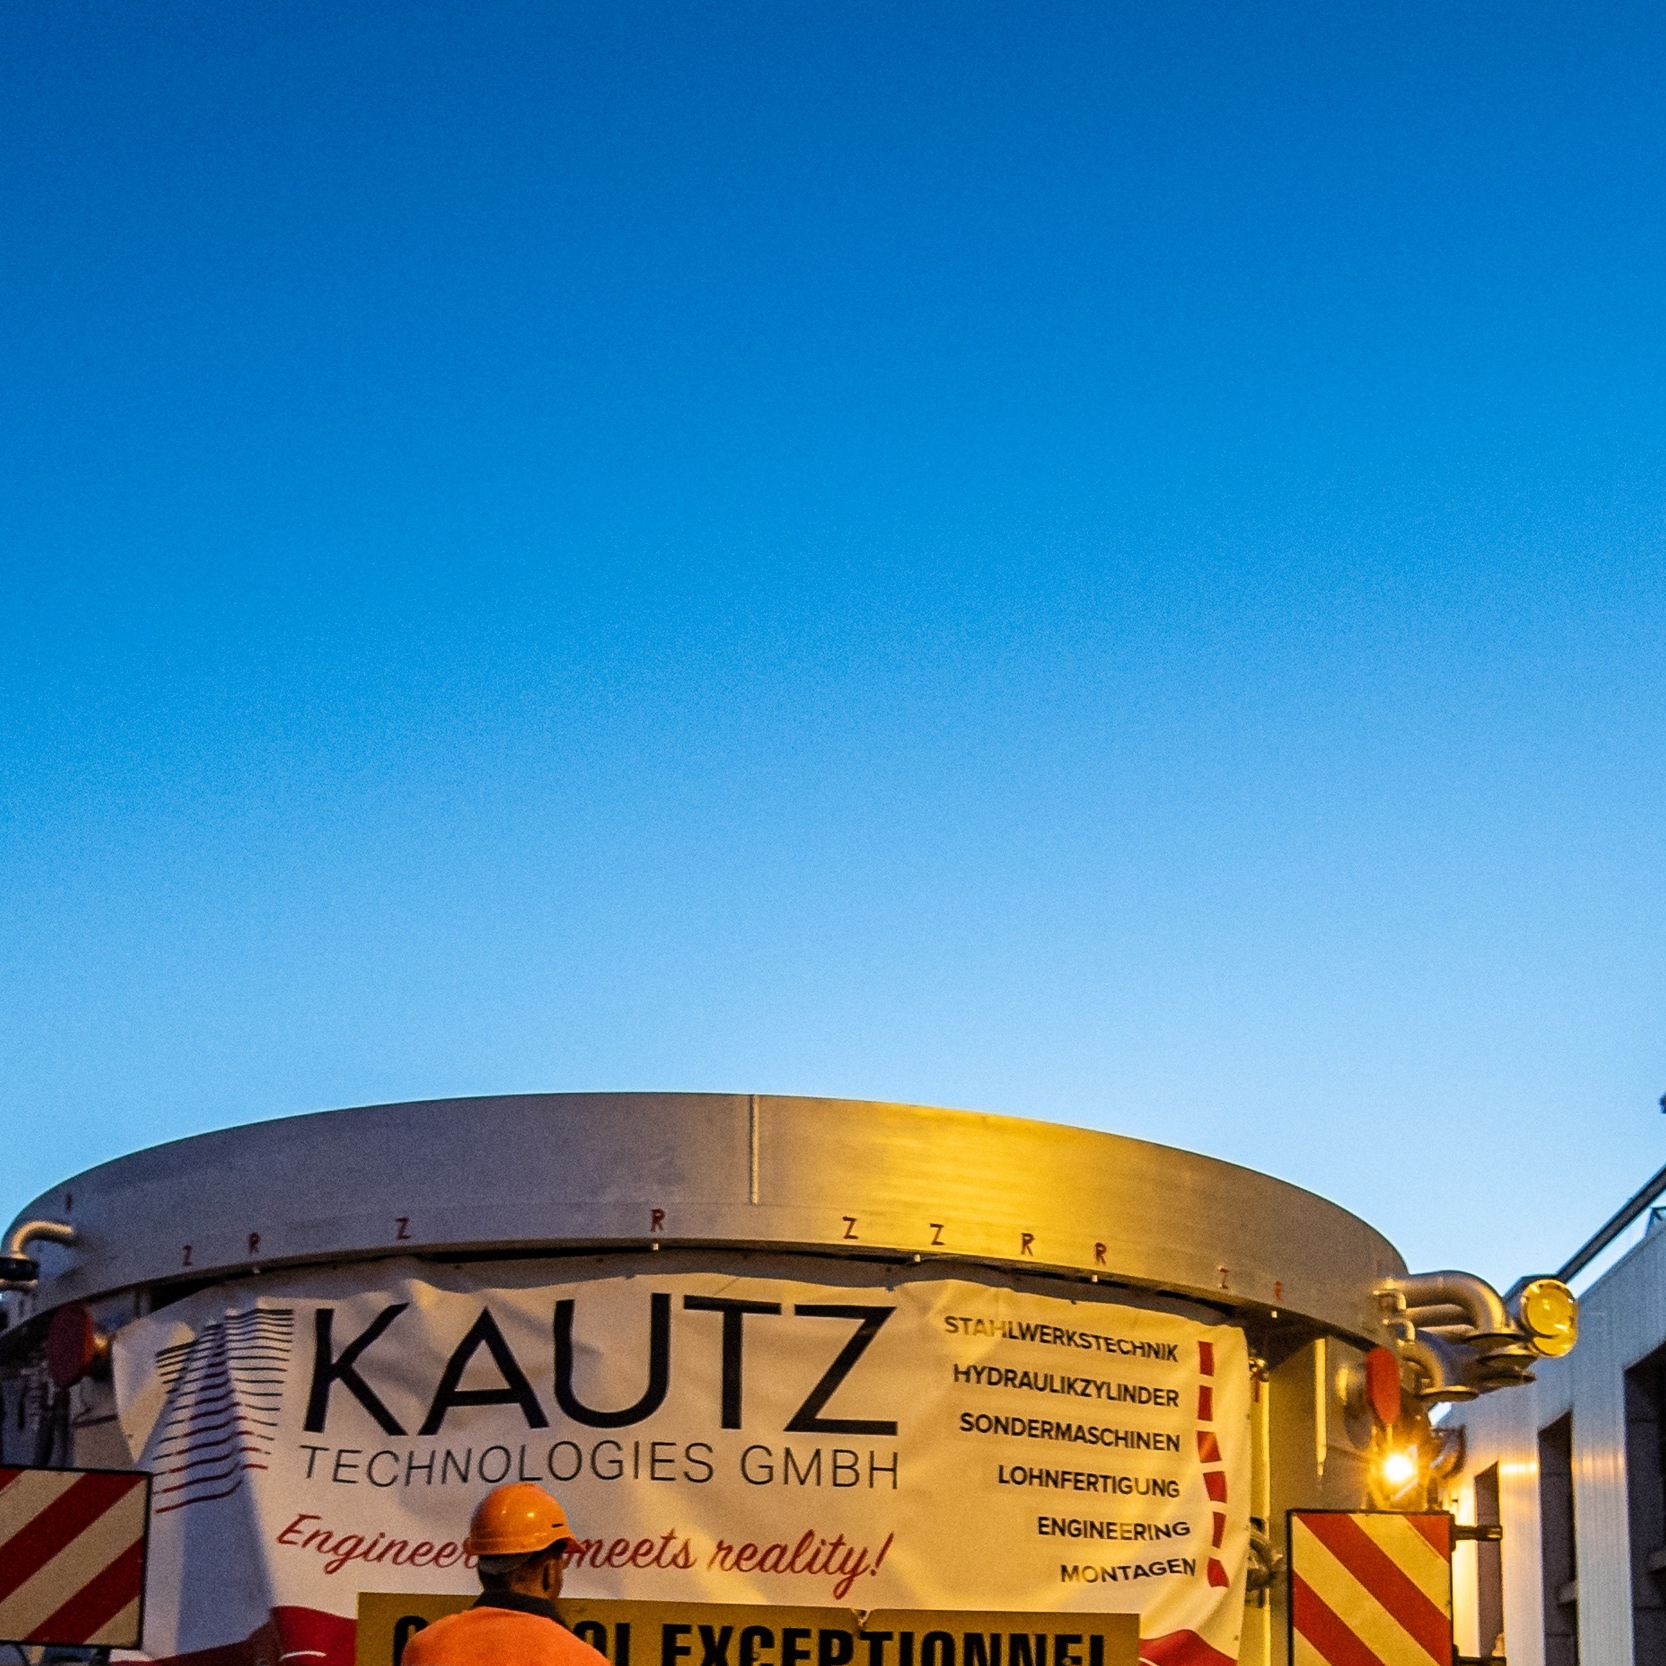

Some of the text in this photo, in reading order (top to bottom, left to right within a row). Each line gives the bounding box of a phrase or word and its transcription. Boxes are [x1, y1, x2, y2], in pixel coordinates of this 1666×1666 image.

[649, 1207, 666, 1232] R
[842, 1216, 859, 1240] Z
[929, 1223, 945, 1246] Z
[1020, 1232, 1036, 1256] R
[1093, 1241, 1107, 1266] R
[944, 1315, 1179, 1363] STAHLWERKSTECHNIK
[303, 1292, 899, 1437] KAUTZ
[953, 1363, 1180, 1408] HYDRAULIKZYLINDER
[959, 1412, 1181, 1453] SONDERMASCHINEN
[298, 1440, 900, 1490] TECHNOLOGIES GMBH
[997, 1464, 1181, 1498] LOHNFERTIGUNG
[1037, 1516, 1191, 1542] ENGINEERING
[562, 1526, 697, 1570] meets
[706, 1528, 895, 1601] reality!
[1059, 1557, 1197, 1584] MONTAGEN
